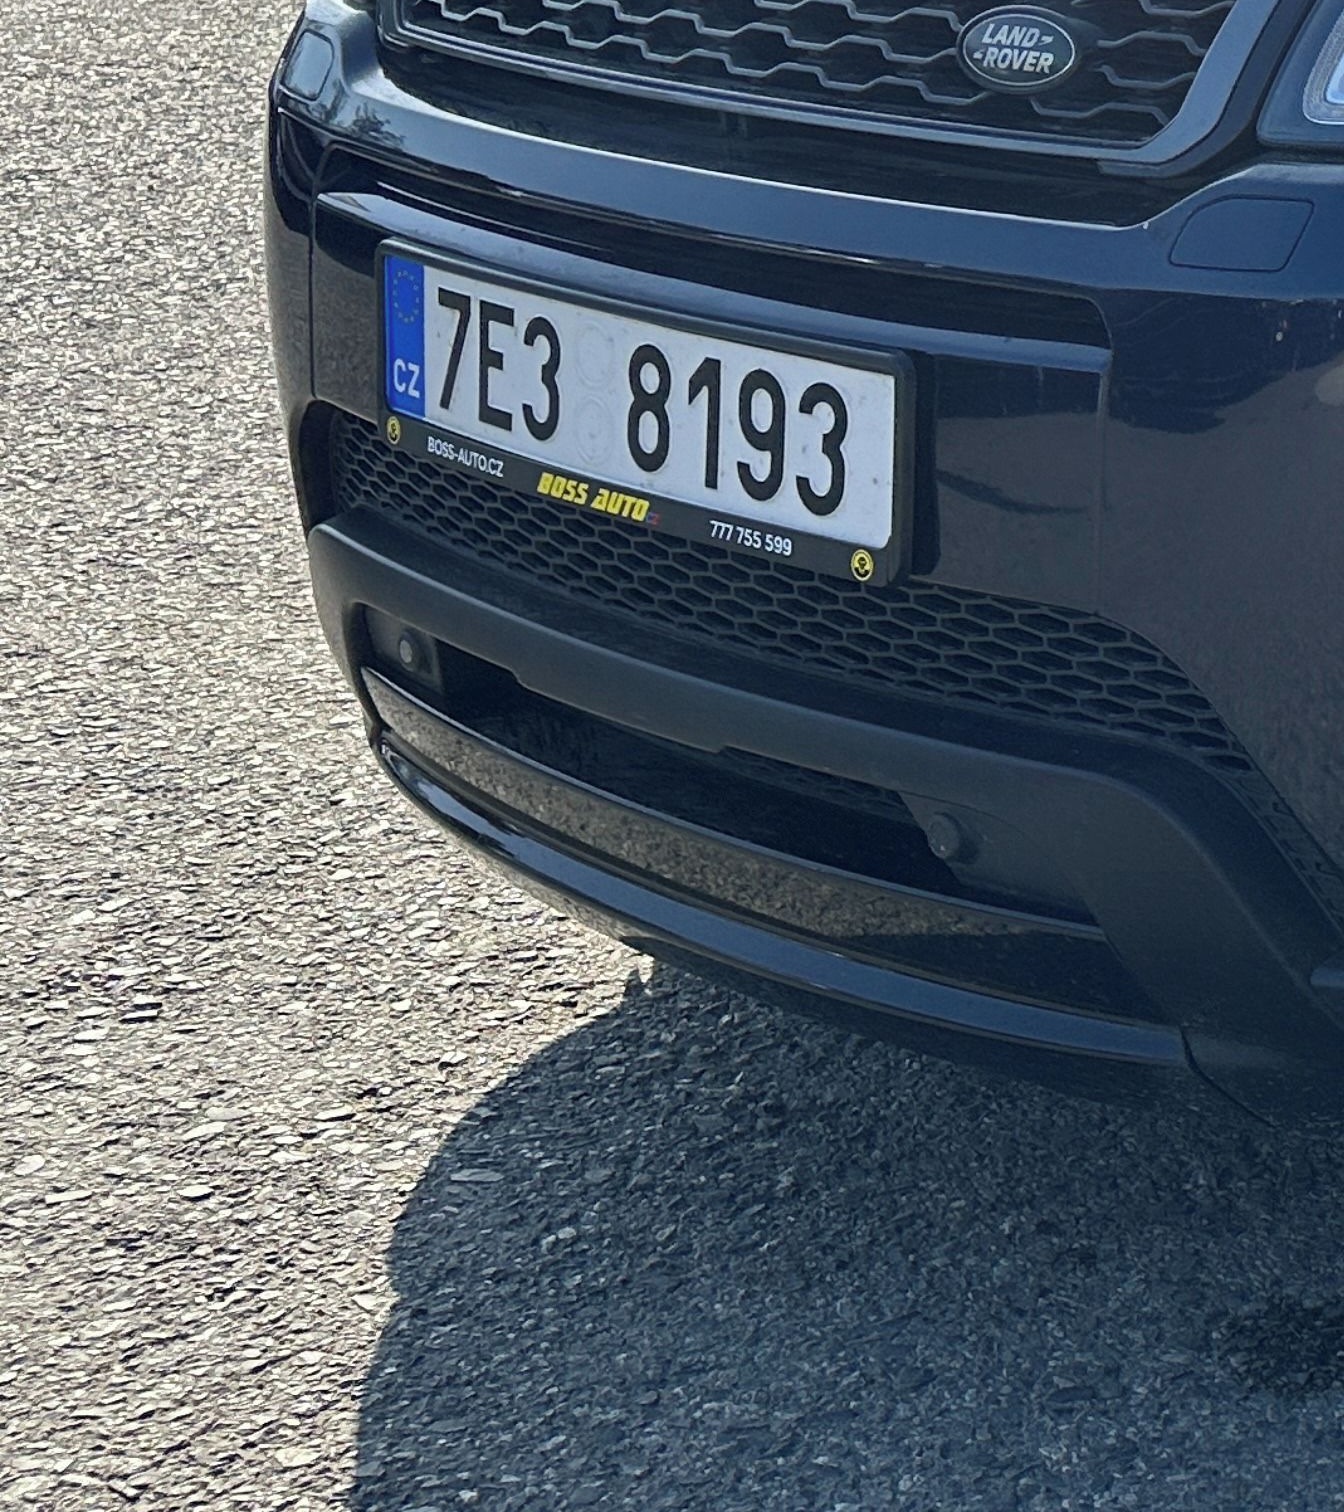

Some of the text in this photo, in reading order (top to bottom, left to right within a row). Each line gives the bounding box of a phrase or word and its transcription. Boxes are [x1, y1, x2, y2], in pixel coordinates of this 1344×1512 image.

[981, 23, 1041, 48] LAND
[982, 46, 1055, 74] ROVER
[393, 358, 420, 398] CZ
[437, 286, 849, 517] 7E3 8193
[427, 435, 504, 478] BOSS-AUTO.CZ
[537, 471, 589, 505] BOSS
[590, 487, 650, 522] AUTO
[709, 518, 793, 557] 777 755 599
